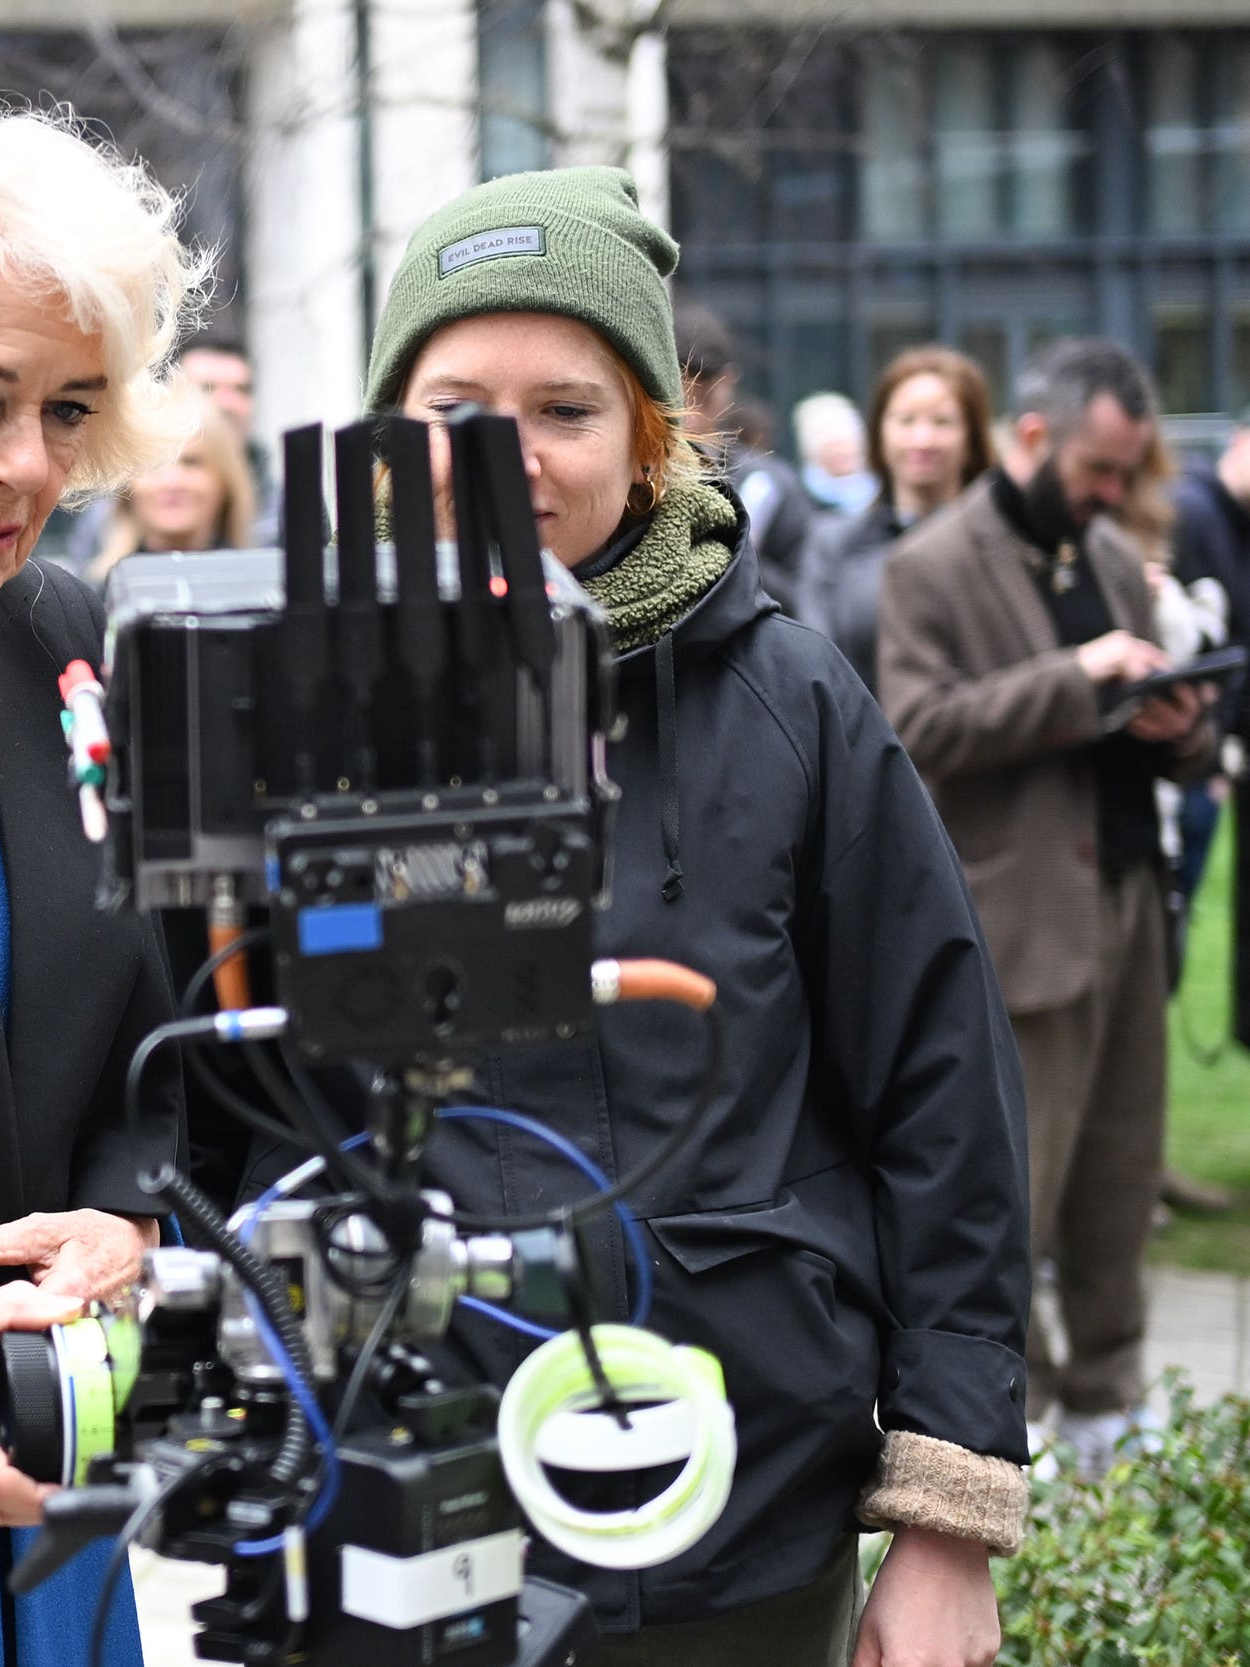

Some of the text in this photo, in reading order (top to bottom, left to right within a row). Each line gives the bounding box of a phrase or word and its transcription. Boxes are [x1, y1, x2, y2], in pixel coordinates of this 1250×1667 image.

[448, 235, 533, 262] EVIL DEAD RISE
